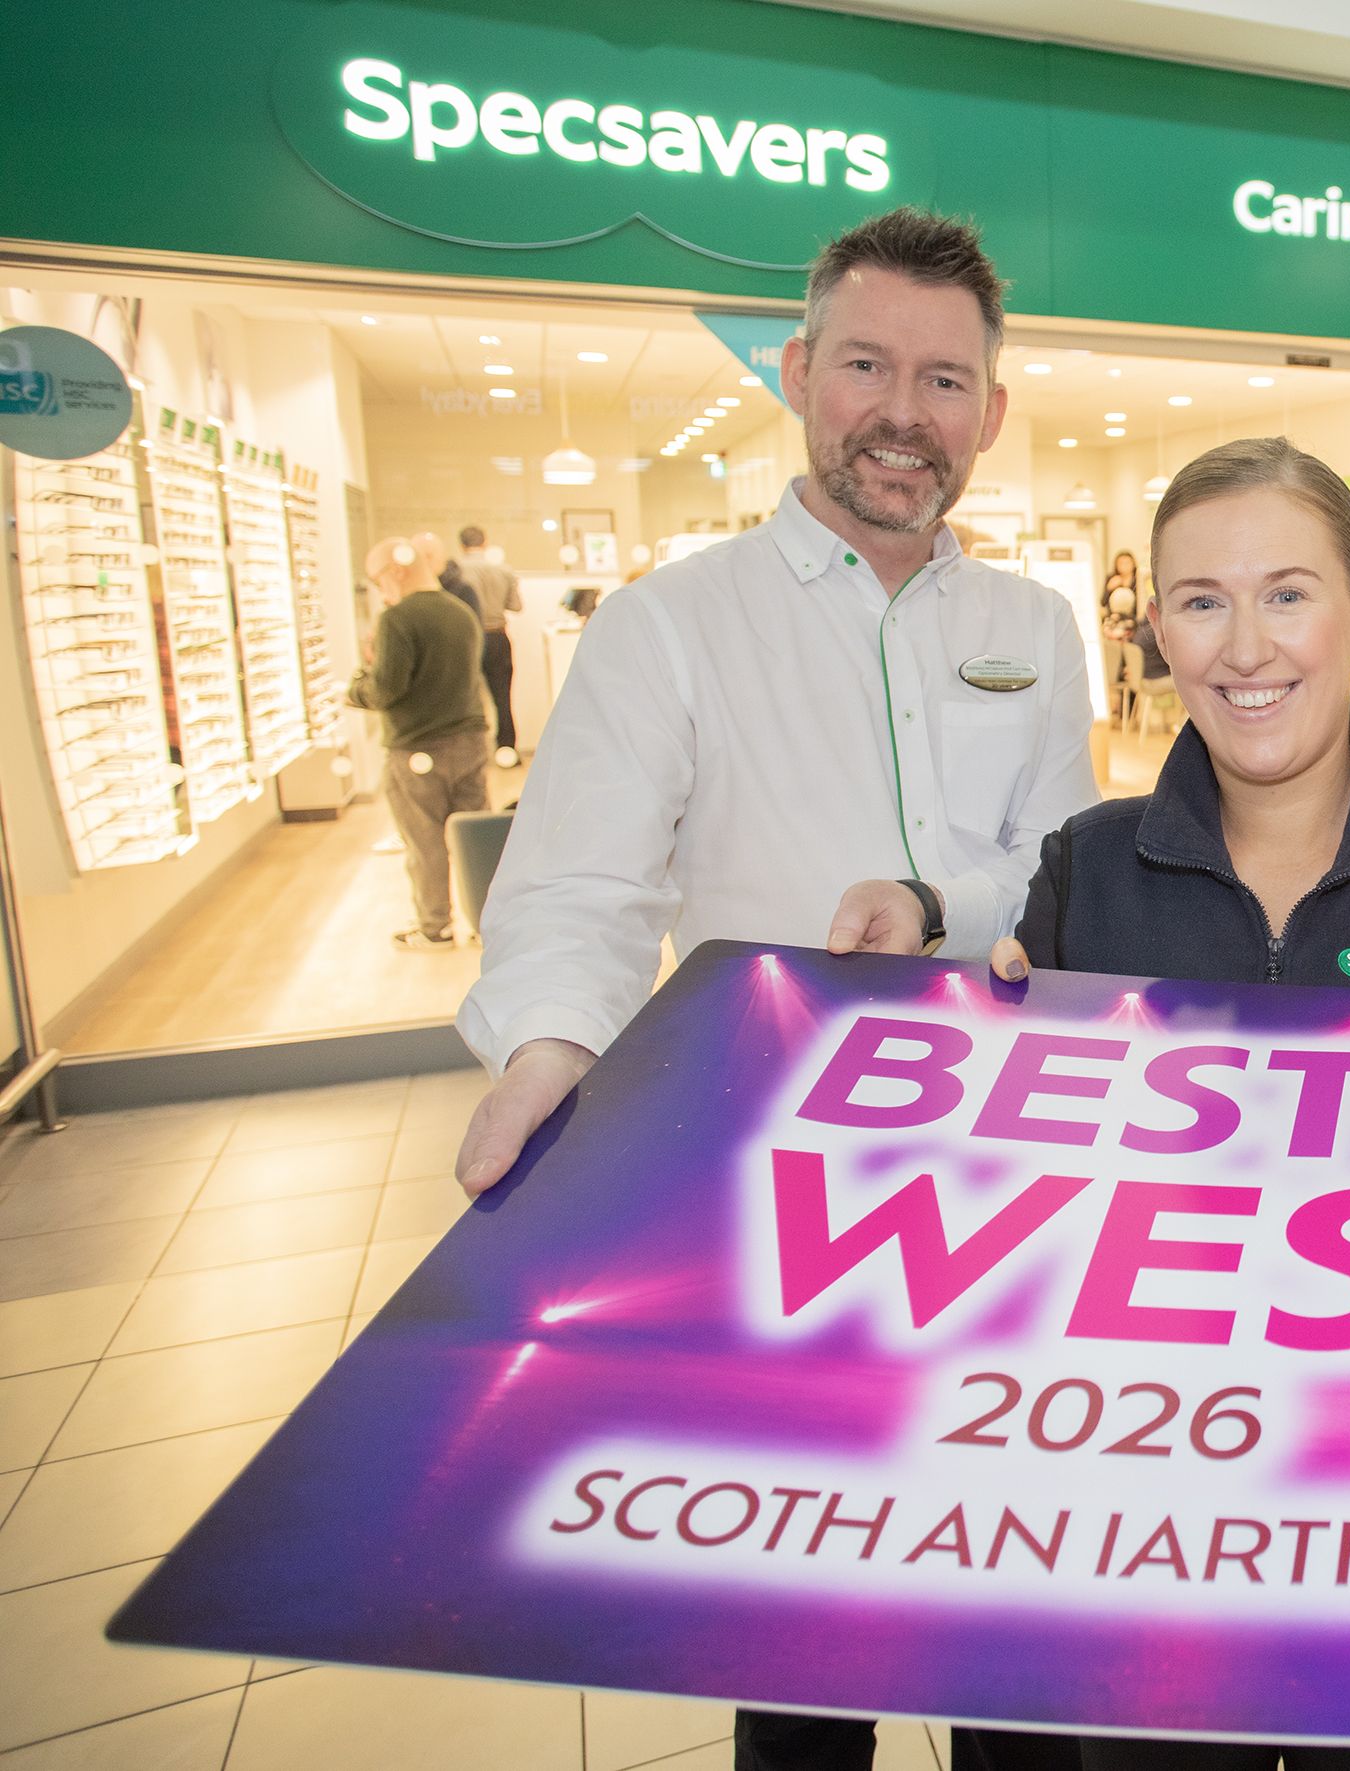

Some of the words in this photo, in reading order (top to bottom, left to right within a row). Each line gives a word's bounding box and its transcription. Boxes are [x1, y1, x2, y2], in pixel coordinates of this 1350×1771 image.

[341, 57, 891, 192] Specsavers
[936, 1371, 1263, 1460] 2026
[549, 1468, 897, 1560] SCOTH
[901, 1502, 1071, 1573] AN
